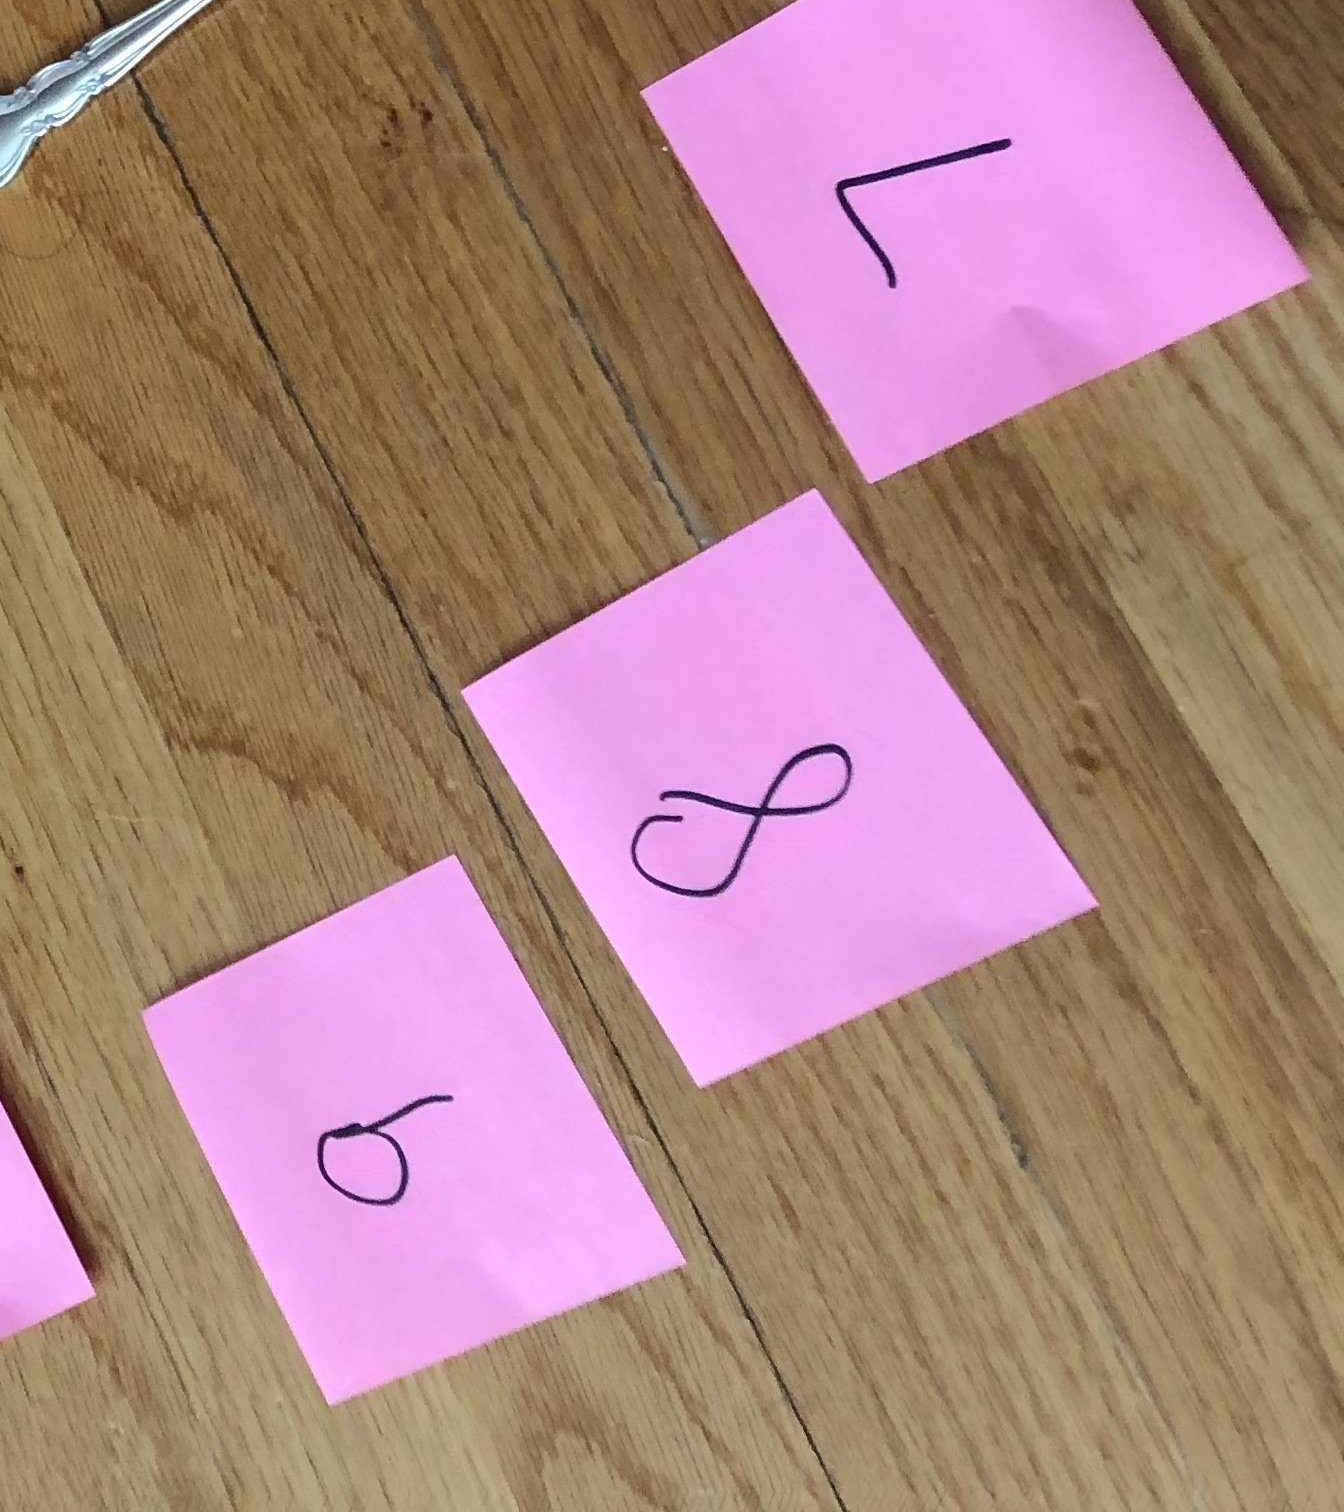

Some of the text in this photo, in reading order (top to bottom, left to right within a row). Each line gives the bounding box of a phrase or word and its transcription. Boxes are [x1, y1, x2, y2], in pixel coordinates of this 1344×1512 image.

[835, 137, 1012, 289] 7
[630, 743, 853, 898] 8
[317, 1094, 453, 1206] 9
